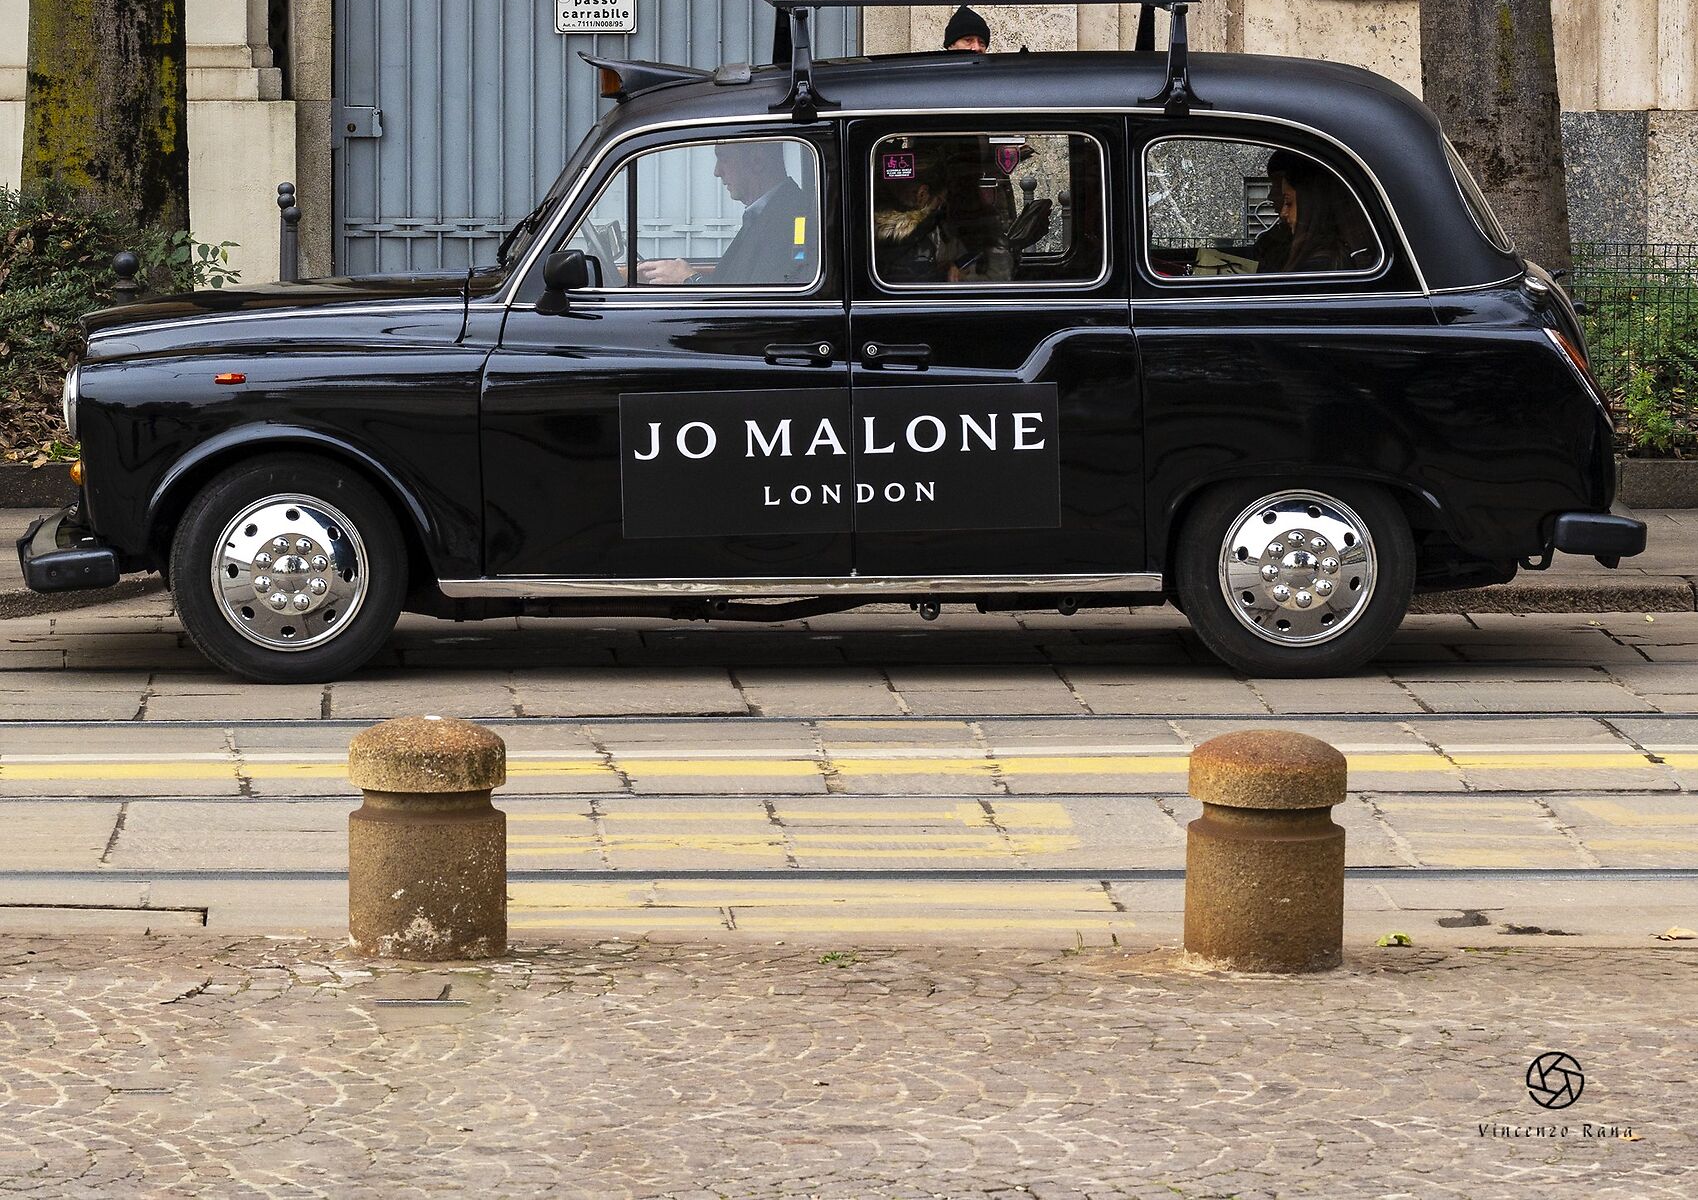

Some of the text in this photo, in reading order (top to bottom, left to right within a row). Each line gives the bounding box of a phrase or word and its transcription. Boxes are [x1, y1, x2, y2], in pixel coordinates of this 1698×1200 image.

[562, 9, 629, 18] carrabile
[633, 412, 1046, 461] JO MALONE
[764, 481, 936, 506] LONDON
